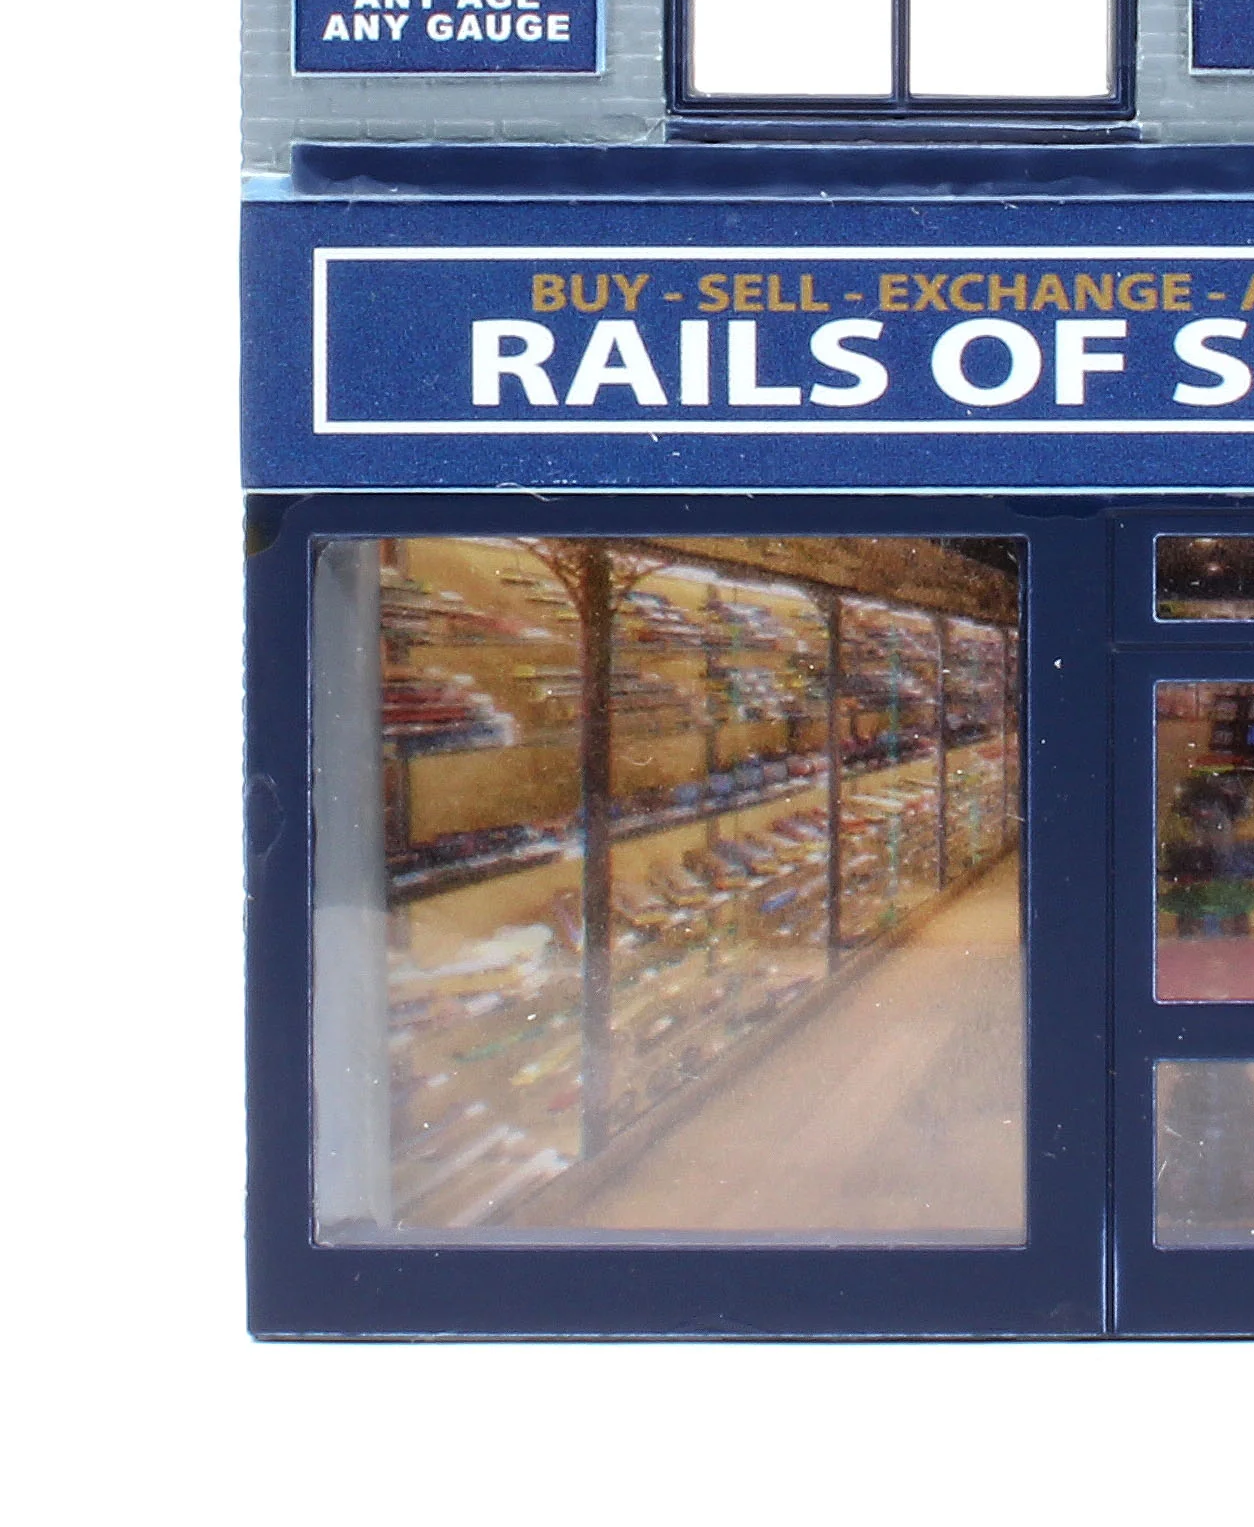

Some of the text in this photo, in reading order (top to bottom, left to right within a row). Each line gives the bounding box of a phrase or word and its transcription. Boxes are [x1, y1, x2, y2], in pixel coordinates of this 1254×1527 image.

[322, 11, 571, 42] ANY GAUGE
[531, 273, 650, 313] BUY
[697, 273, 830, 313] SELL
[878, 271, 1193, 313] EXCHANGE
[471, 317, 889, 408] RAILS
[930, 317, 1129, 408] OF
